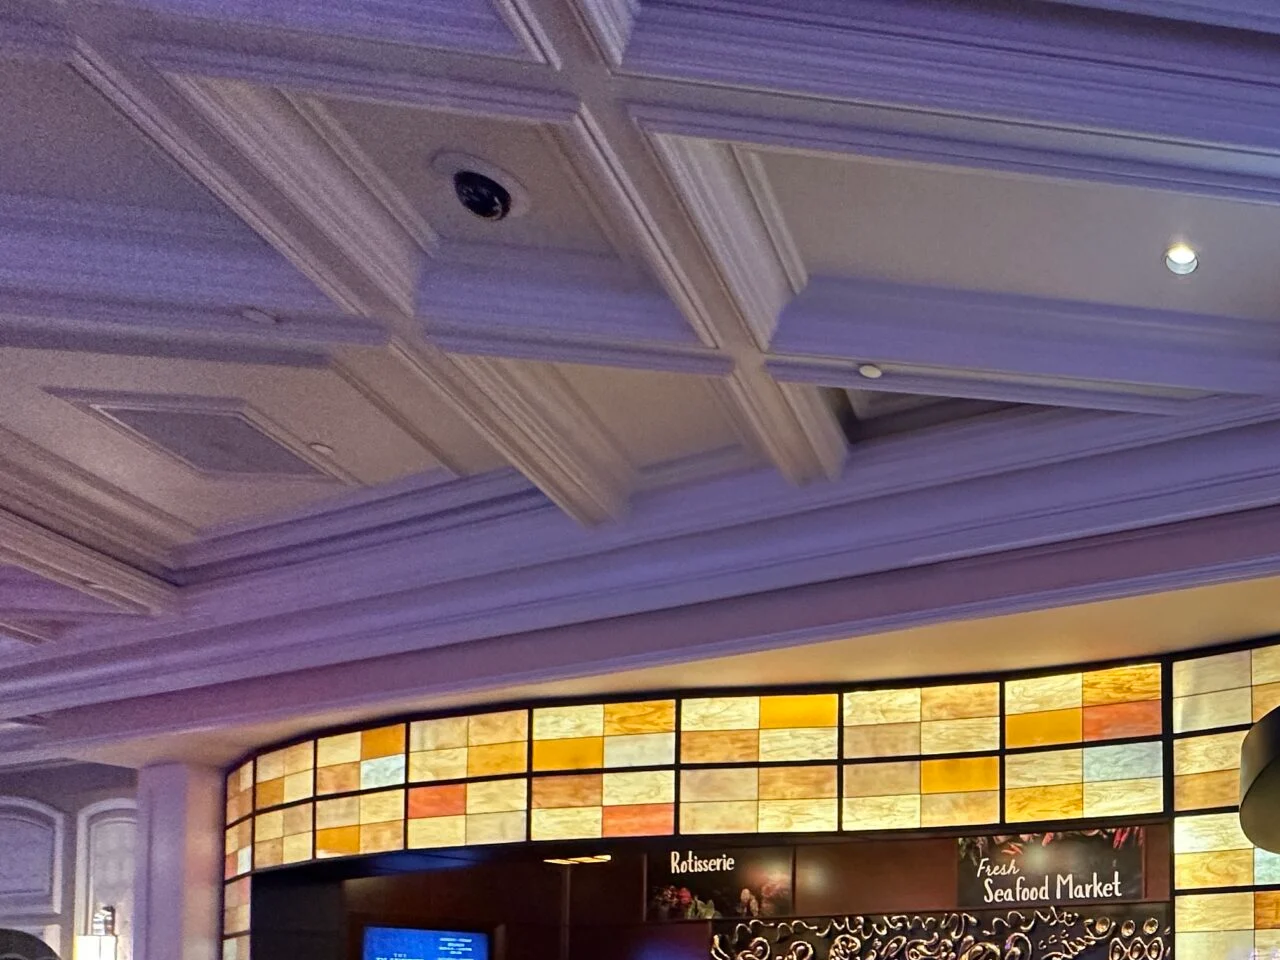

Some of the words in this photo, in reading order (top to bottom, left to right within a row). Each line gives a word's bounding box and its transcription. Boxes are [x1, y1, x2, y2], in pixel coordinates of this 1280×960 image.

[671, 850, 735, 874] Rotisserie
[976, 857, 1021, 878] Fresh
[983, 874, 1050, 903] Seafood
[1056, 870, 1122, 900] Market
